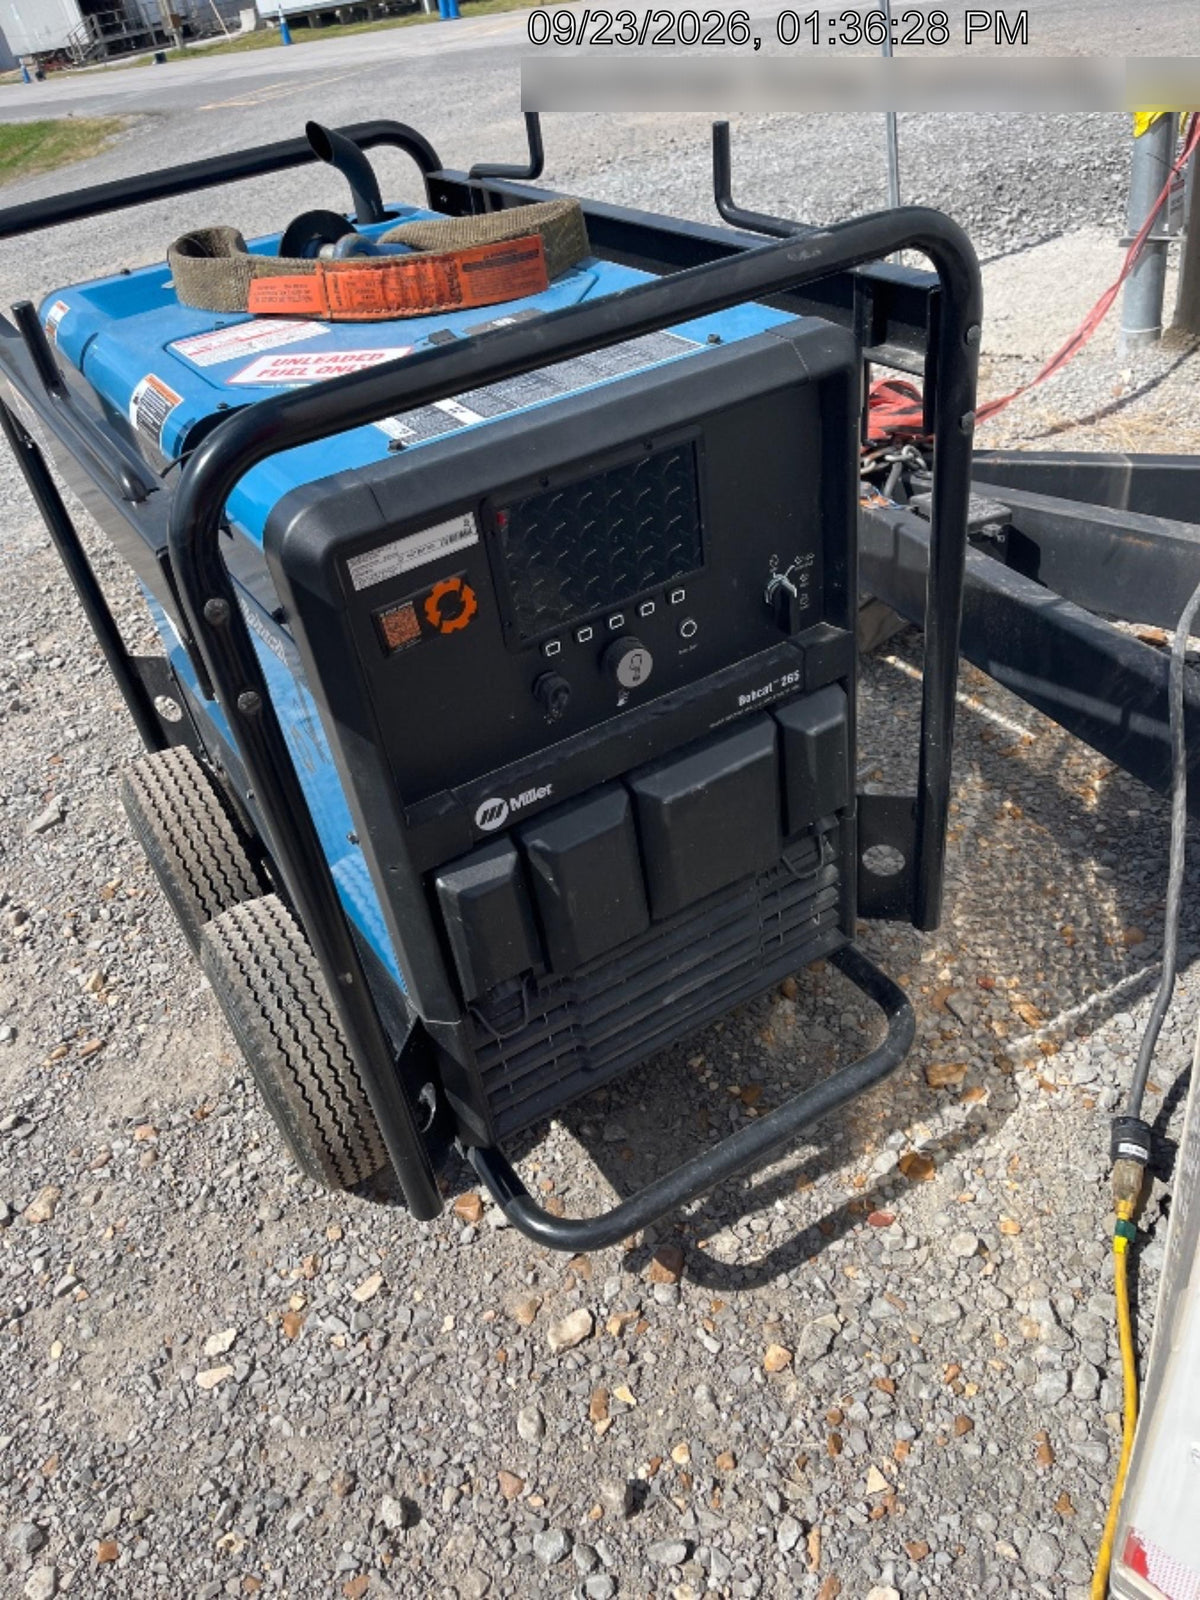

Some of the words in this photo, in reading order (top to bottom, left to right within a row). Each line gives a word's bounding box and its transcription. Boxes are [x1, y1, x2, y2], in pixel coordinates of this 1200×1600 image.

[270, 352, 385, 367] UNLEADED
[256, 367, 309, 378] FUEL
[510, 783, 553, 811] Miller
